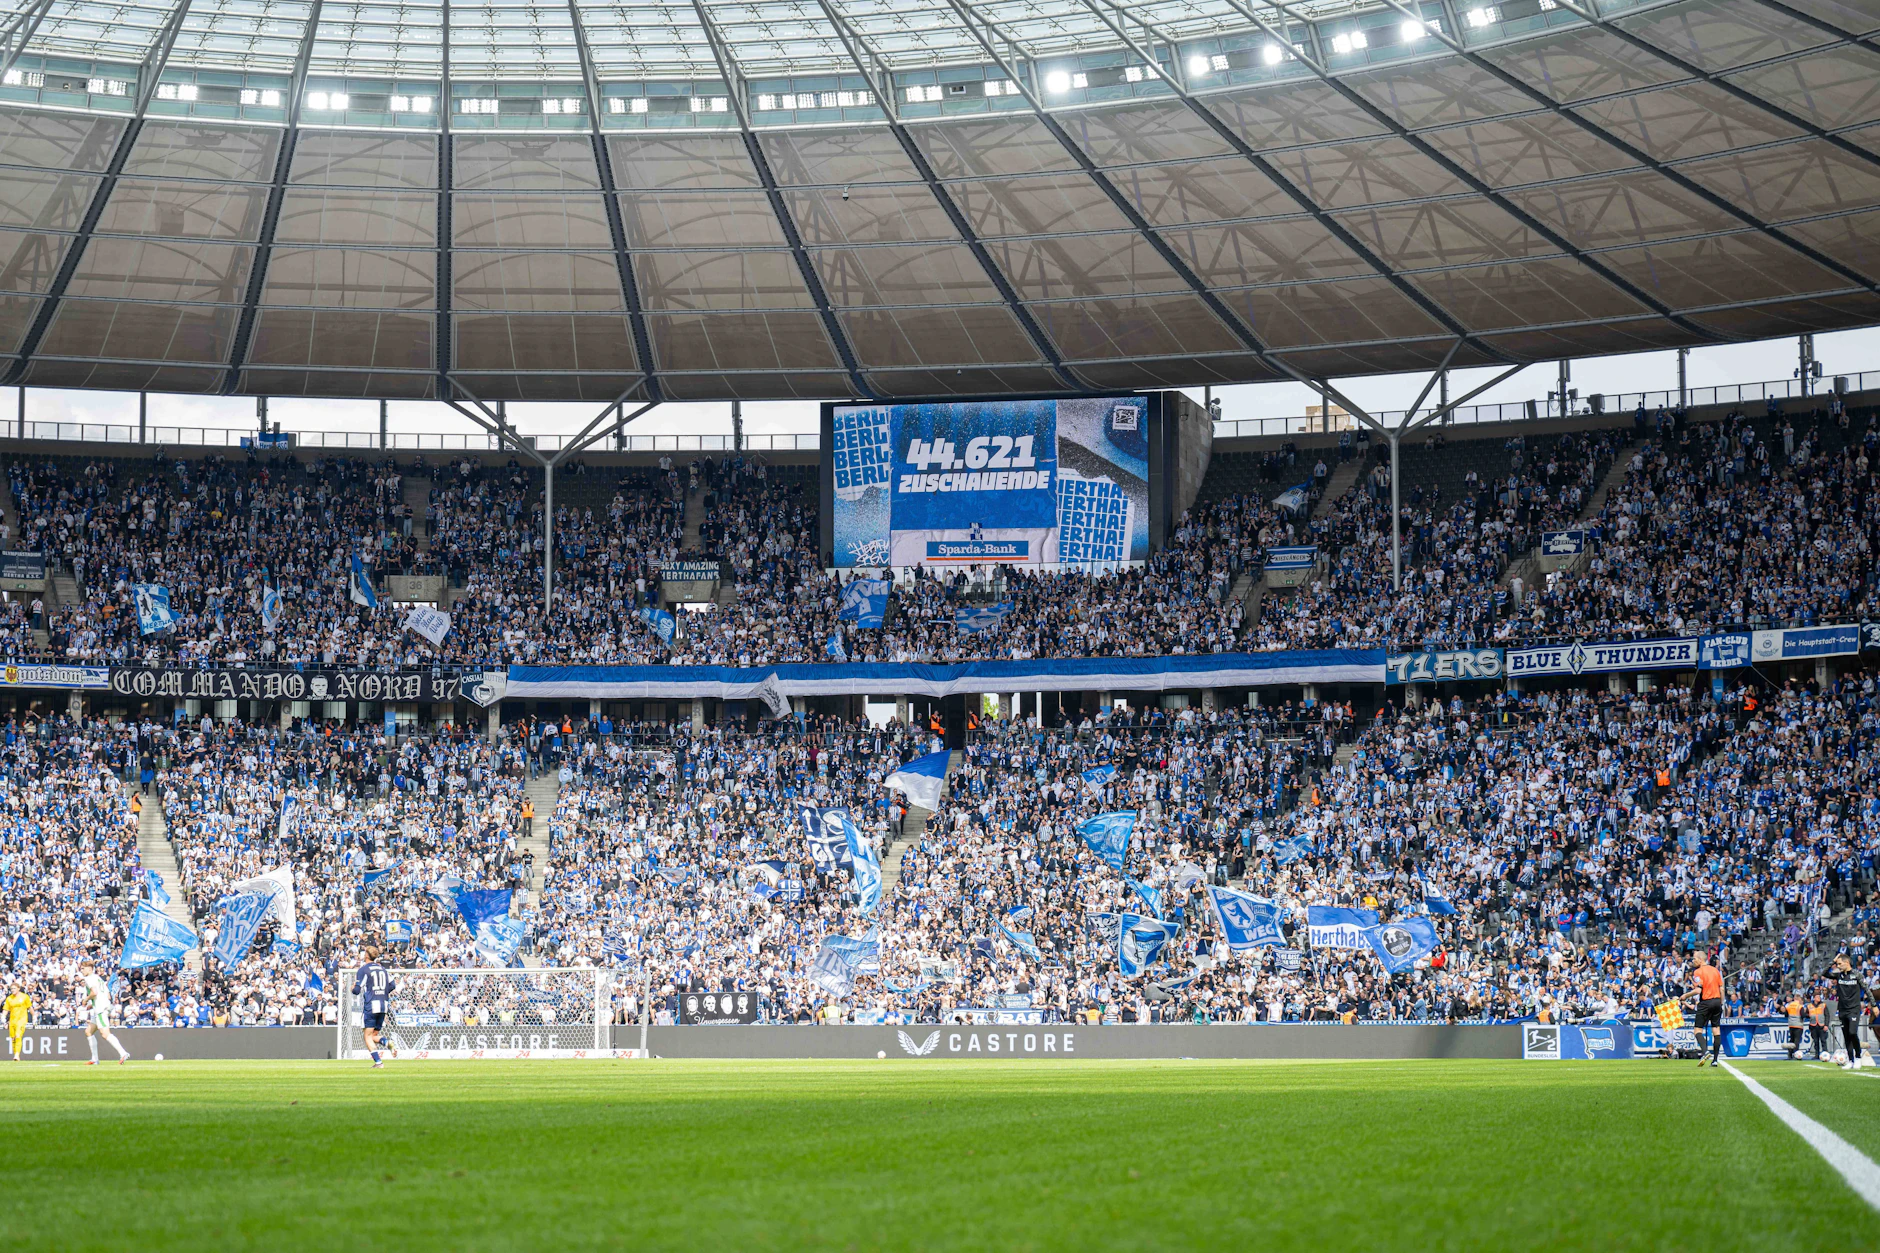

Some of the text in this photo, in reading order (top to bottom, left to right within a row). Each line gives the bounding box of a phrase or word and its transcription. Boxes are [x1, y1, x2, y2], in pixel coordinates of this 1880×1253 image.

[906, 435, 1036, 470] 44.621
[899, 470, 1050, 493] ZUSCHAUENDE
[938, 543, 1016, 555] Sparda-Bank
[683, 561, 719, 570] AMAZING
[409, 581, 422, 590] 36
[1704, 635, 1748, 648] FAN-CLUB
[1784, 640, 1796, 648] Die
[1798, 636, 1856, 648] Hauptstadt-Crew
[1512, 644, 1691, 670] BLUE THUNDER
[1387, 650, 1502, 682] 71ERS
[462, 674, 484, 684] CASUAL
[335, 673, 421, 700] NORD
[1406, 689, 1414, 698] S
[72, 700, 80, 710] Q
[283, 705, 291, 714] Q
[1243, 924, 1275, 941] WEG
[371, 971, 386, 990] 10
[440, 1034, 558, 1050] CASTORE
[949, 1033, 1074, 1051] CASTORE
[1547, 1040, 1556, 1050] 2
